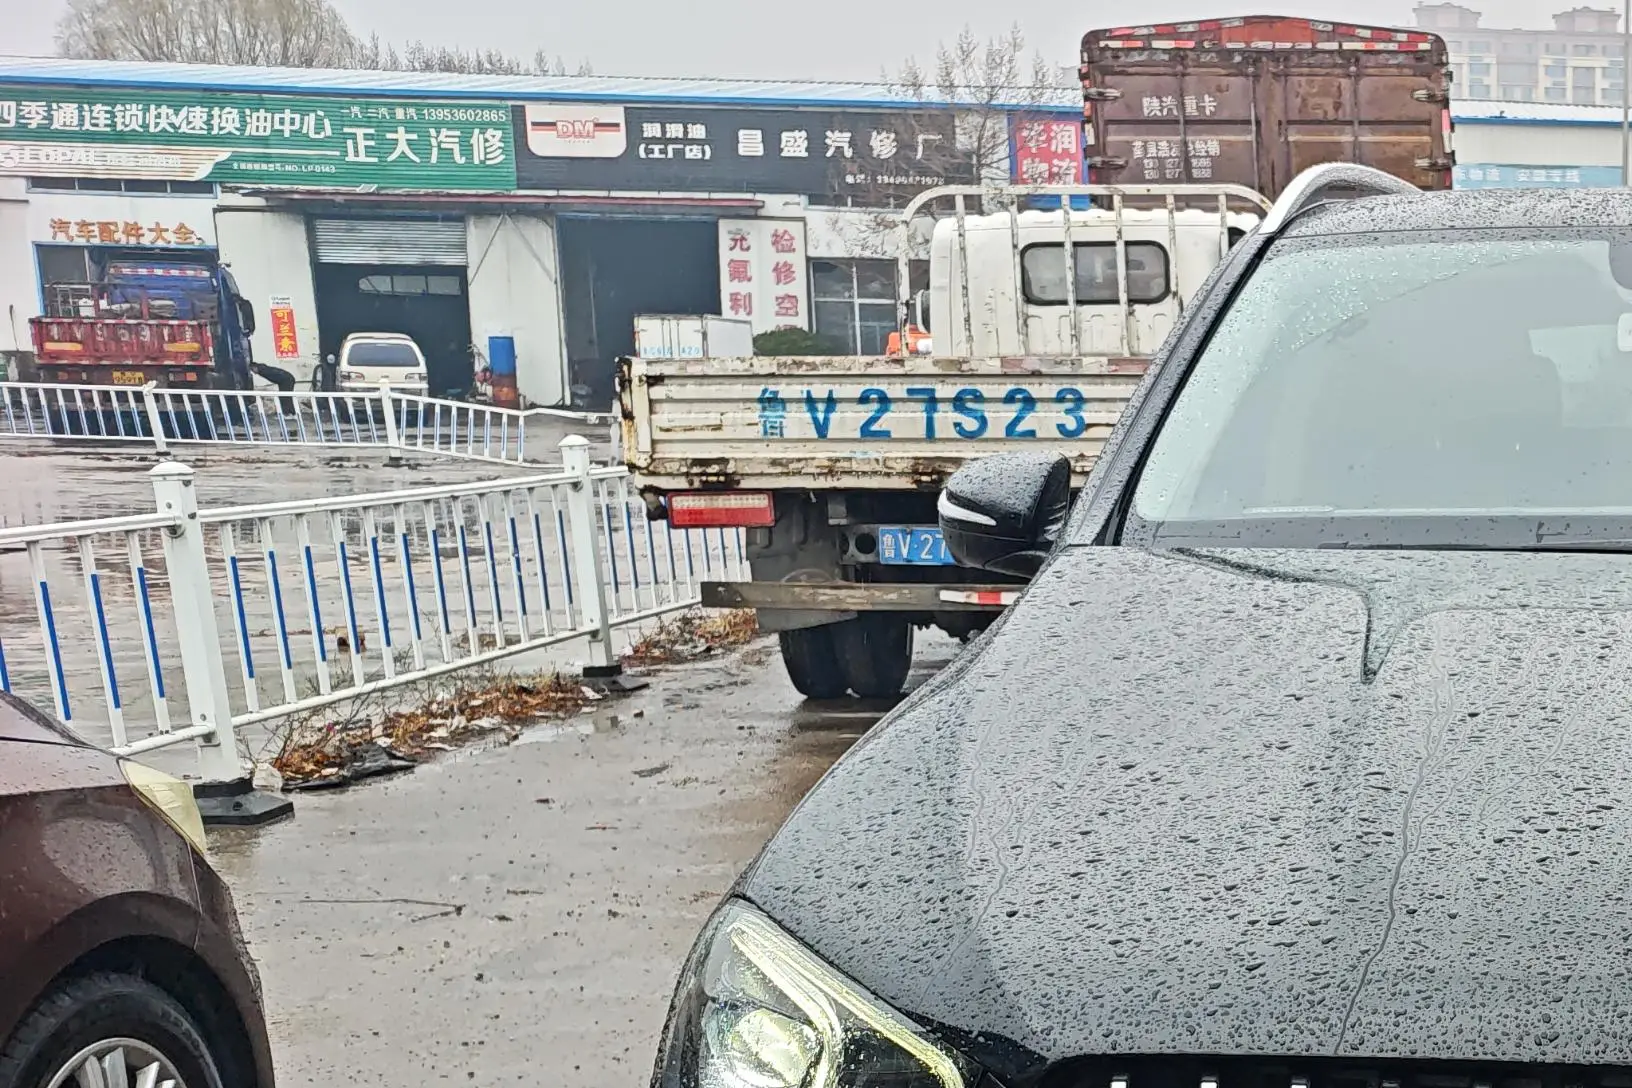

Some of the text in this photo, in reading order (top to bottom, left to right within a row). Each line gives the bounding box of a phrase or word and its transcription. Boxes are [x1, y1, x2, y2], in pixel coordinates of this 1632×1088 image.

[422, 108, 506, 121] 13953602865
[1142, 94, 1217, 116] 陕汽重卡
[642, 122, 706, 139] 润滑油
[737, 129, 943, 160] 昌盛汽修厂
[343, 126, 506, 165] 正大汽修
[50, 217, 195, 245] 汽车配件大全
[757, 387, 1087, 440] 鲁V27S23
